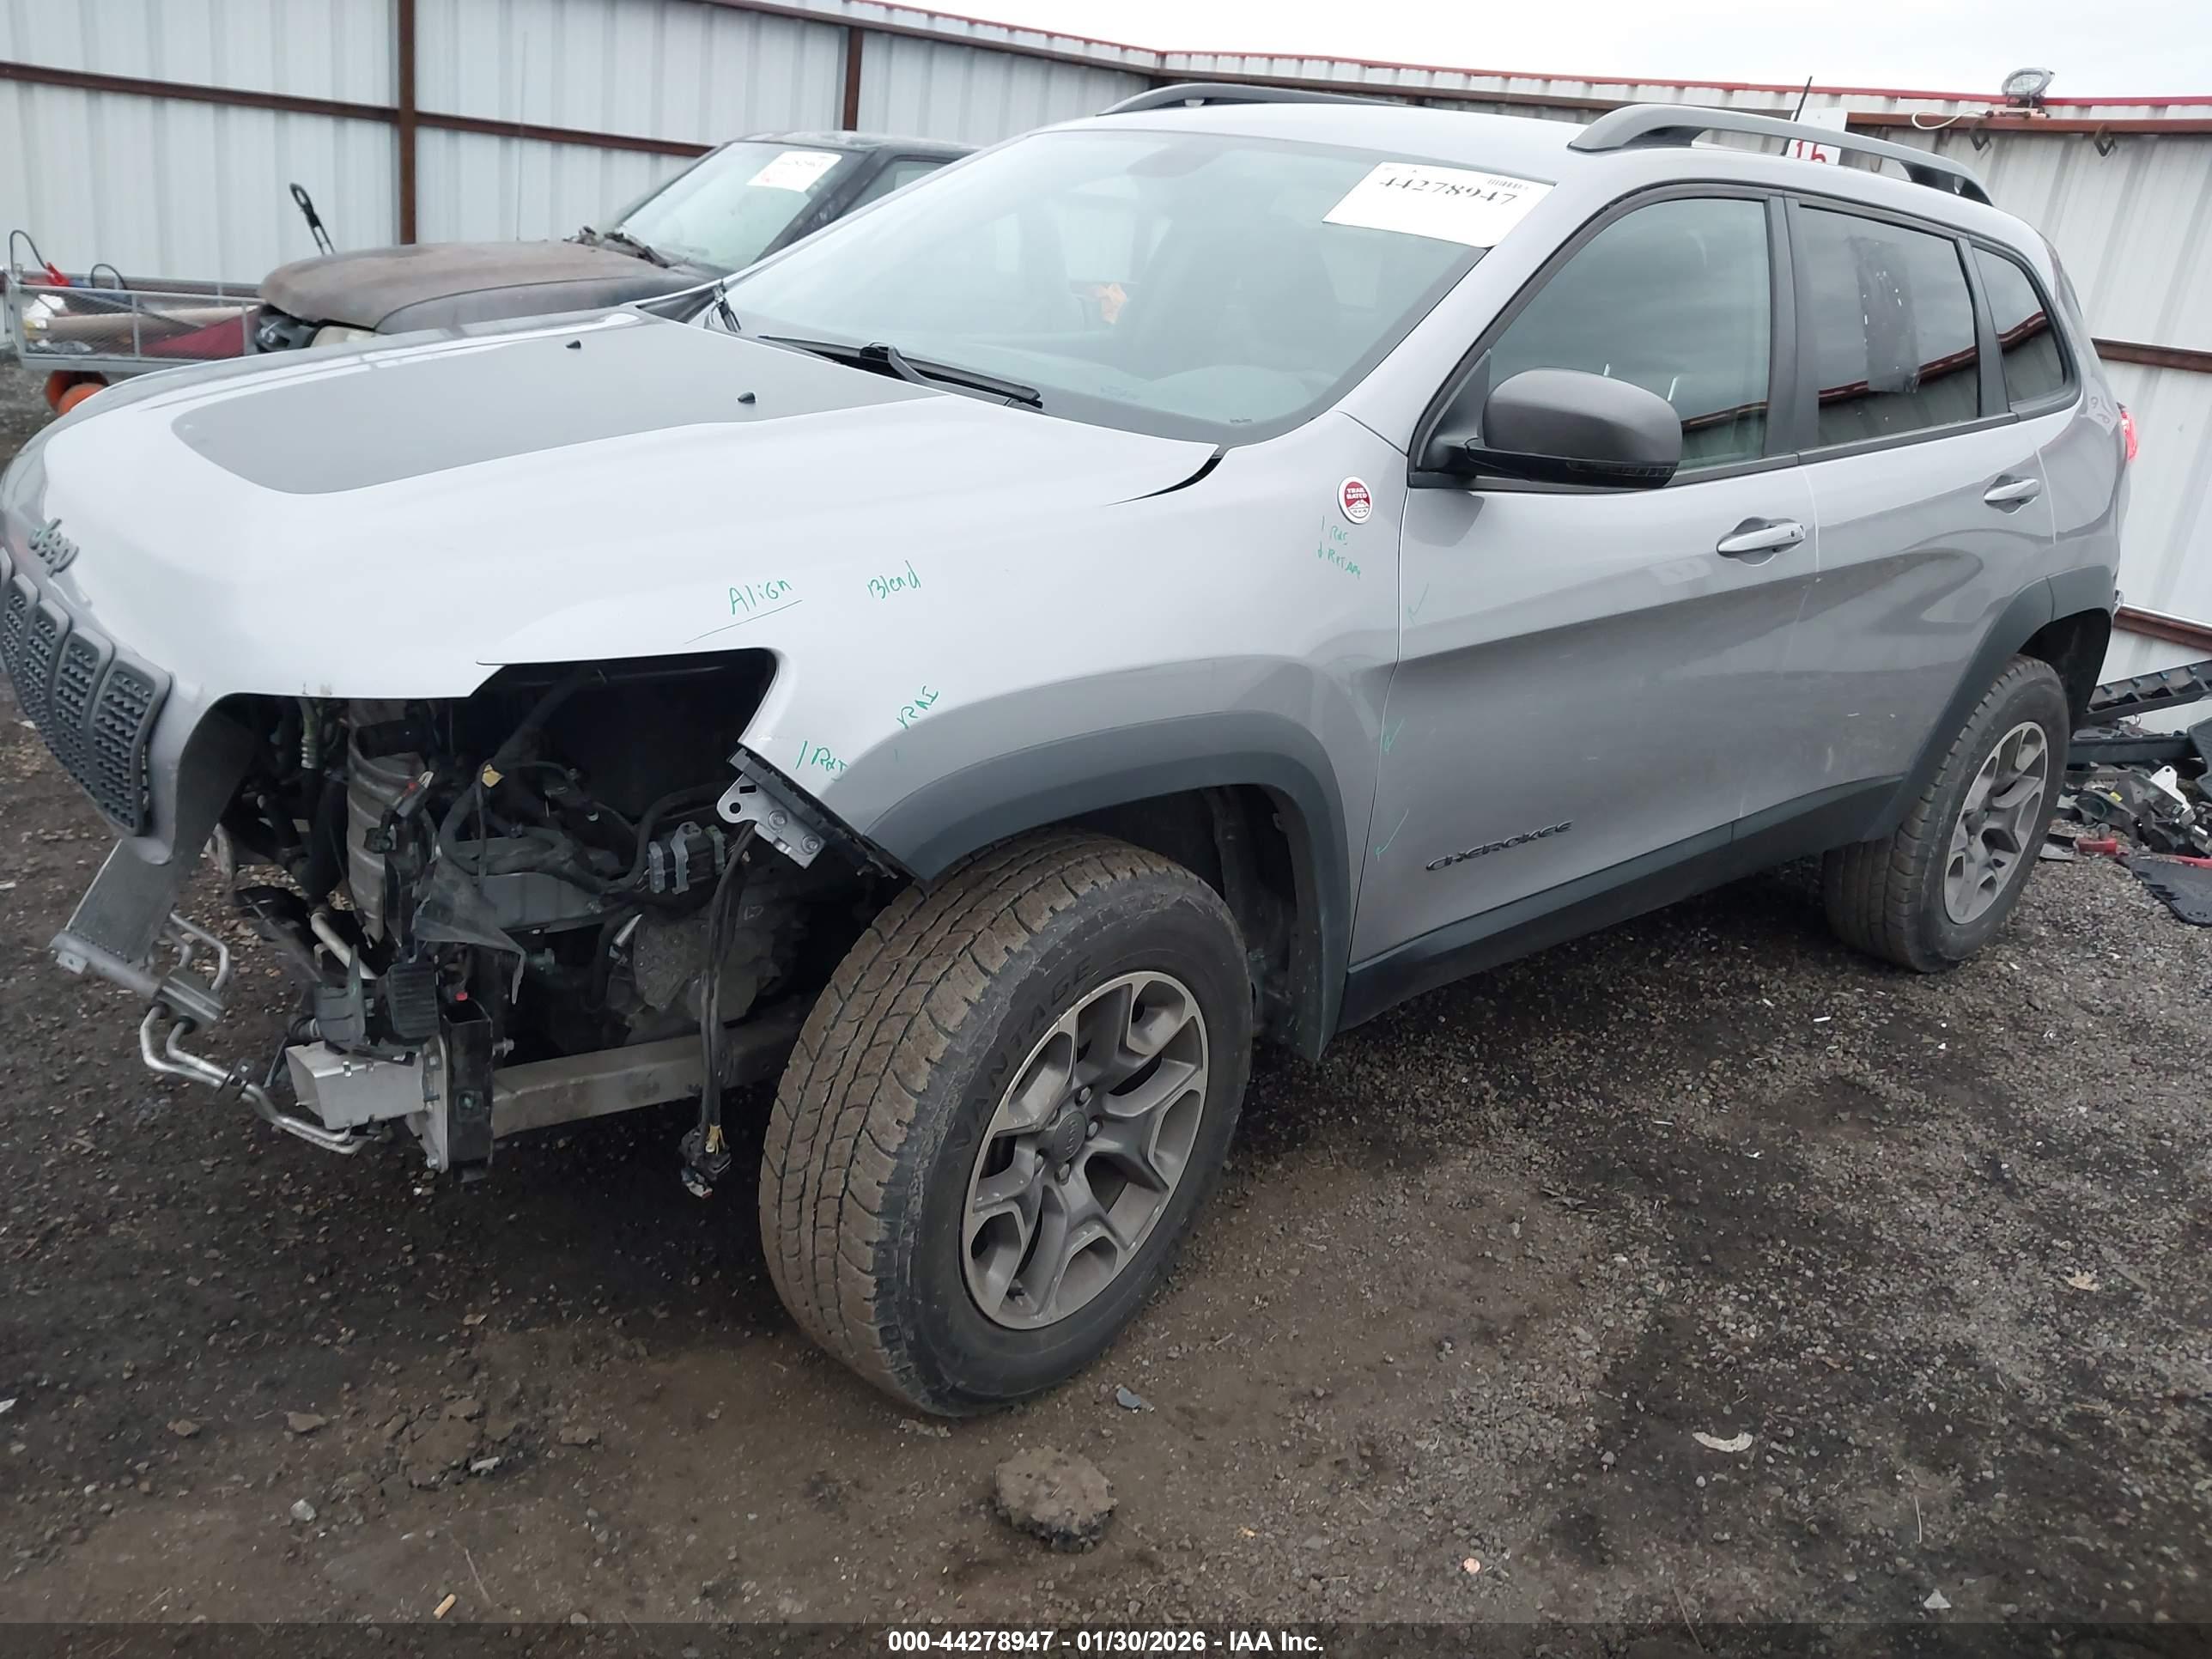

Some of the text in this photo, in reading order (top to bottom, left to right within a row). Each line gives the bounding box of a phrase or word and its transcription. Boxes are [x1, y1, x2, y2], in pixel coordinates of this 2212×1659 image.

[1378, 176, 1518, 205] 44278947
[867, 560, 921, 599] Blend
[1425, 819, 1575, 872] CHEROKEE
